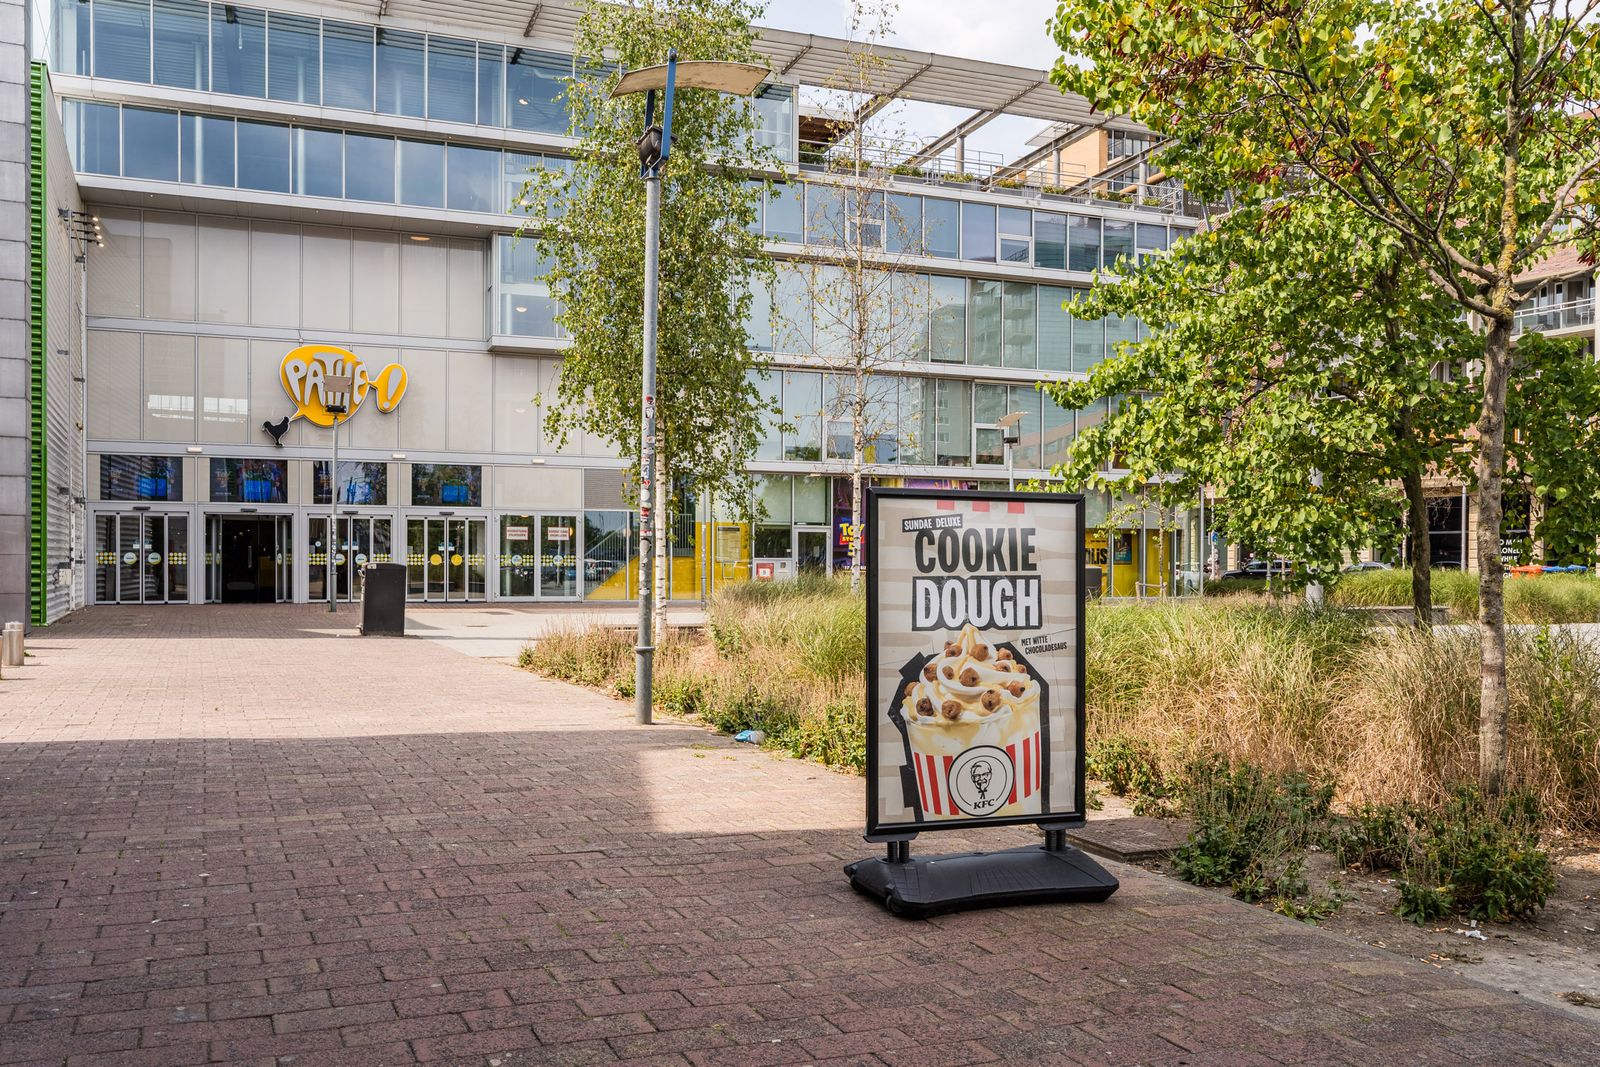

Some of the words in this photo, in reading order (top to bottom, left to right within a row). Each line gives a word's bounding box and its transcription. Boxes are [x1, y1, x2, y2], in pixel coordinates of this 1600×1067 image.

[904, 518, 933, 531] SUNDAE
[935, 516, 961, 528] DELUXE
[915, 527, 1038, 573] COOKIE
[916, 579, 1039, 628] DOUGH
[1021, 637, 1031, 646] MET
[1032, 635, 1048, 645] WITTE
[1025, 641, 1068, 655] CHOCOLADESAUS
[973, 799, 995, 810] KFC
